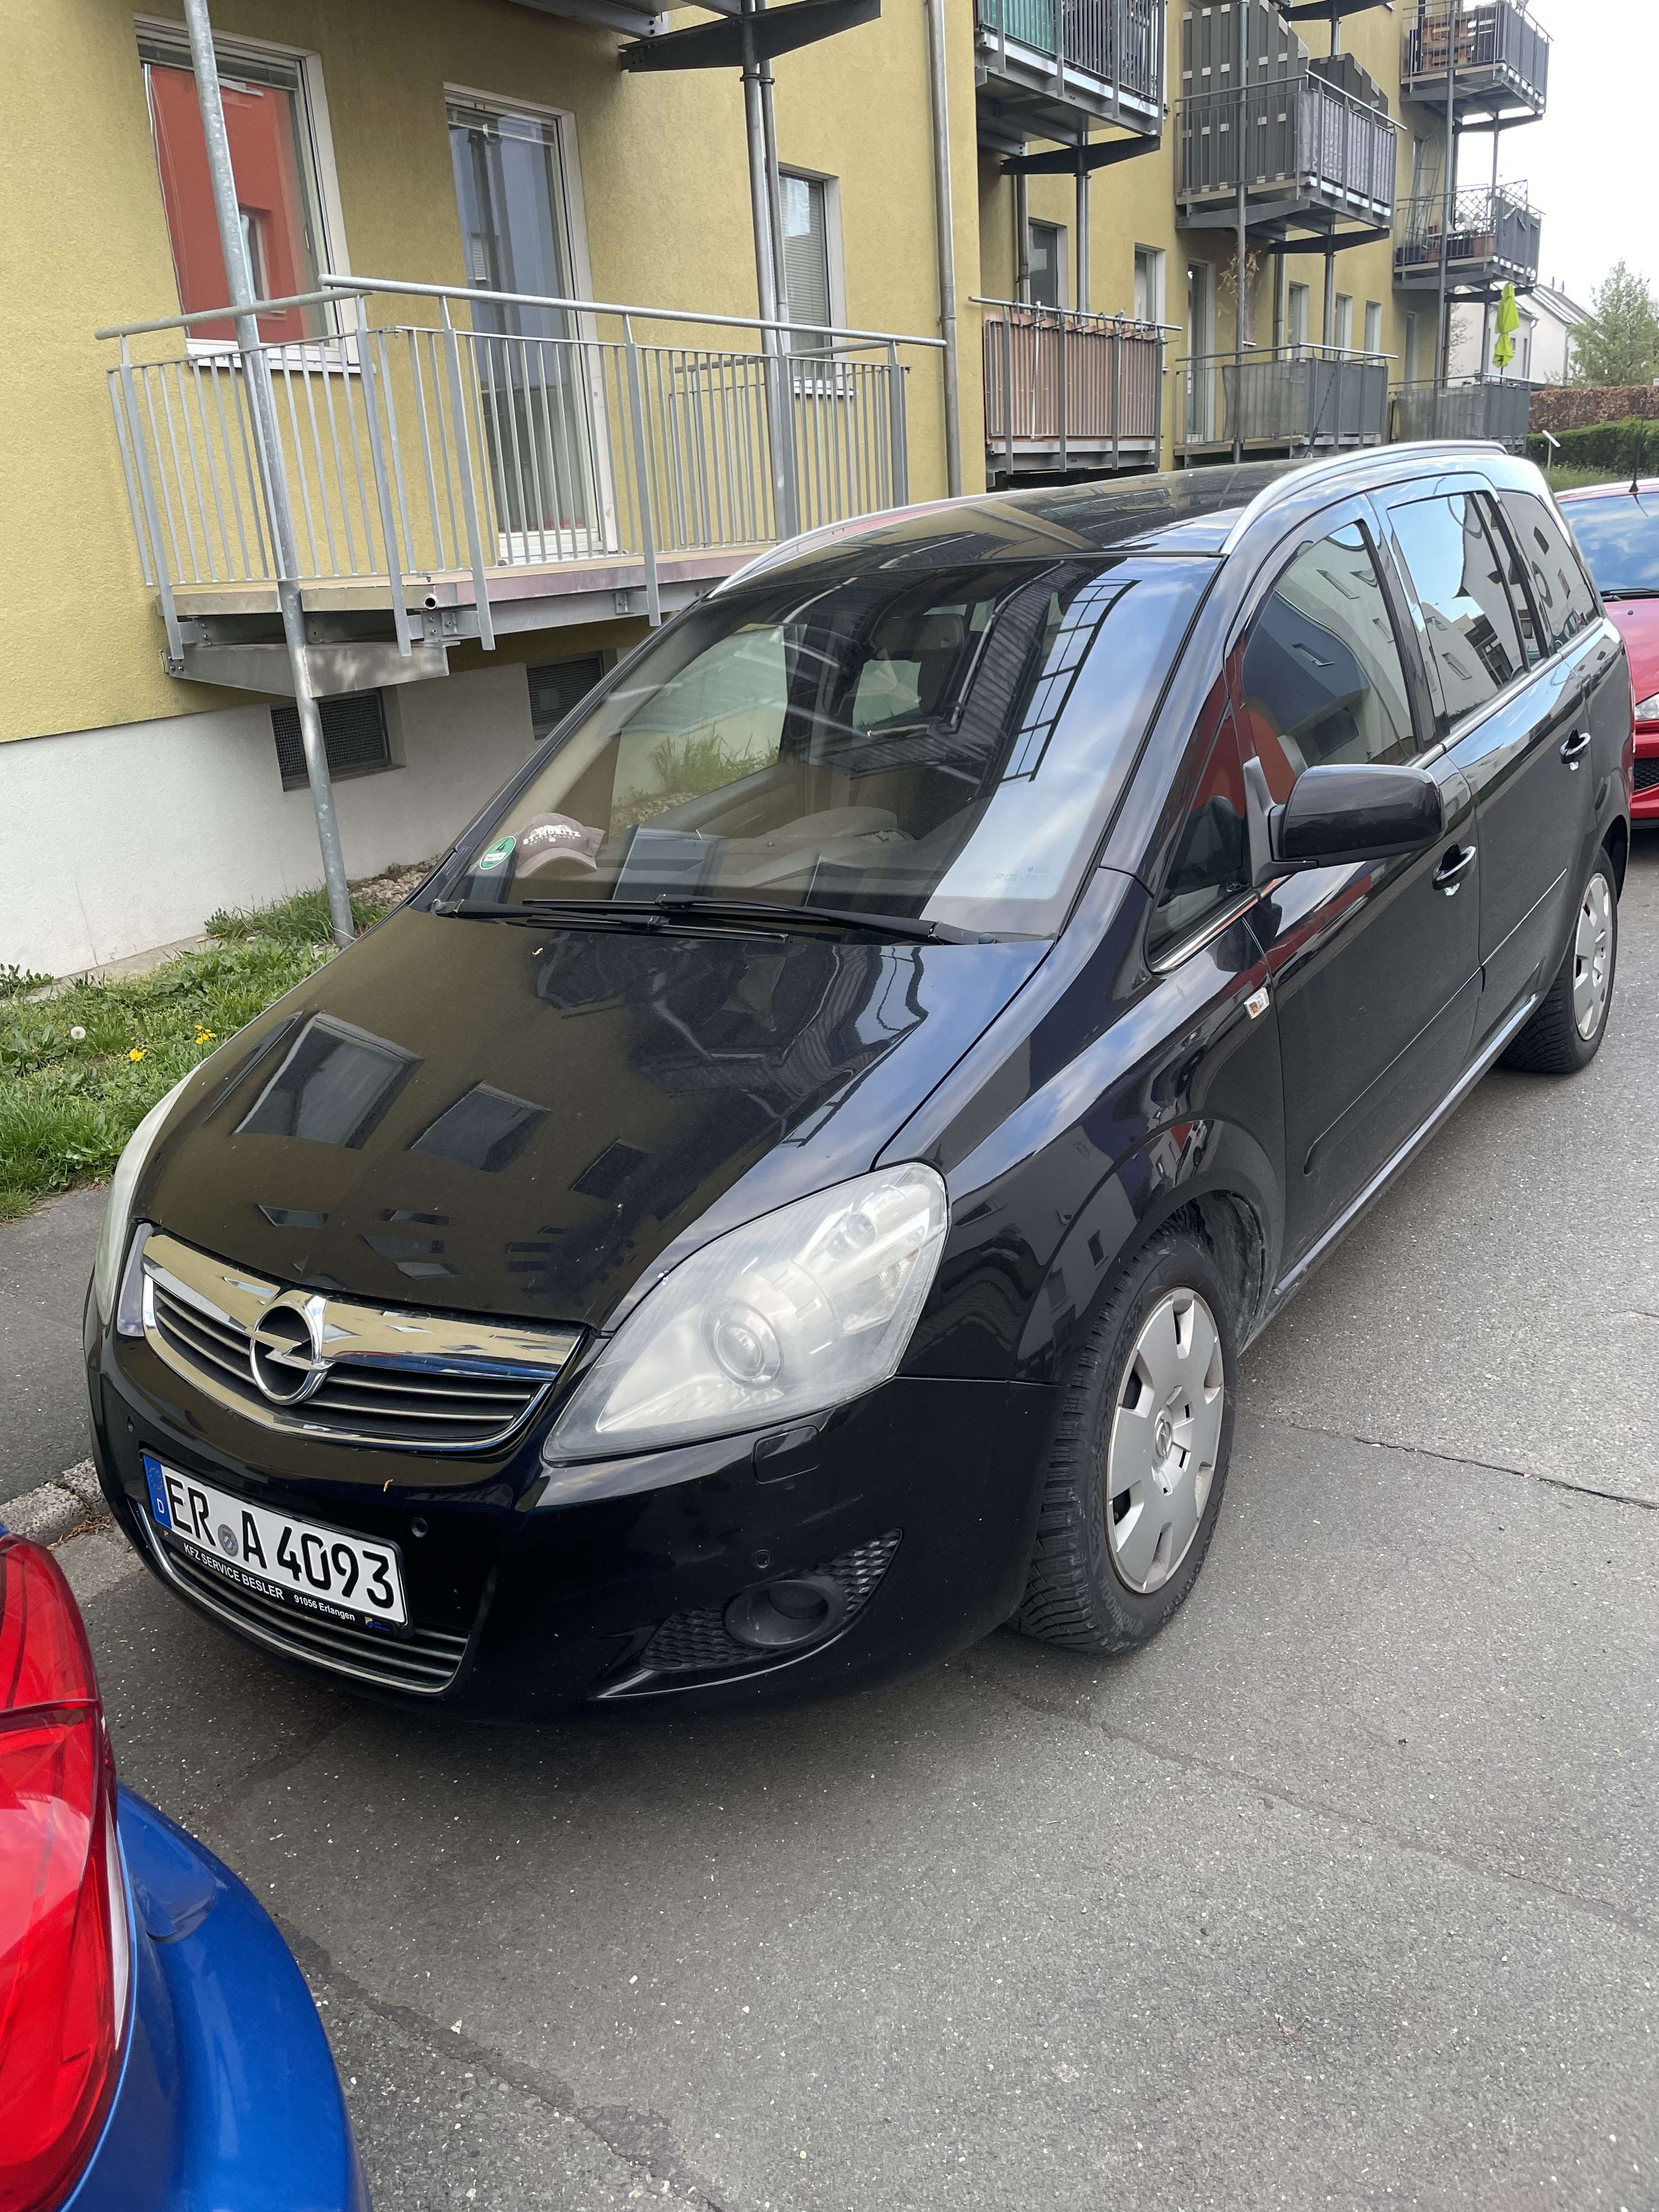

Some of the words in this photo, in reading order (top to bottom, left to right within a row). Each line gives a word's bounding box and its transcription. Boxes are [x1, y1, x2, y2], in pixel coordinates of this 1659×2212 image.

[495, 838, 509, 852] 4
[157, 1498, 165, 1514] D
[165, 1475, 217, 1547] ER
[242, 1510, 268, 1570] A
[277, 1526, 394, 1609] 4093
[183, 1542, 201, 1561] KFZ
[201, 1553, 241, 1582] SERVICE
[241, 1573, 285, 1600] BESLER
[294, 1594, 318, 1609] 91056
[319, 1602, 356, 1621] Erlangen
